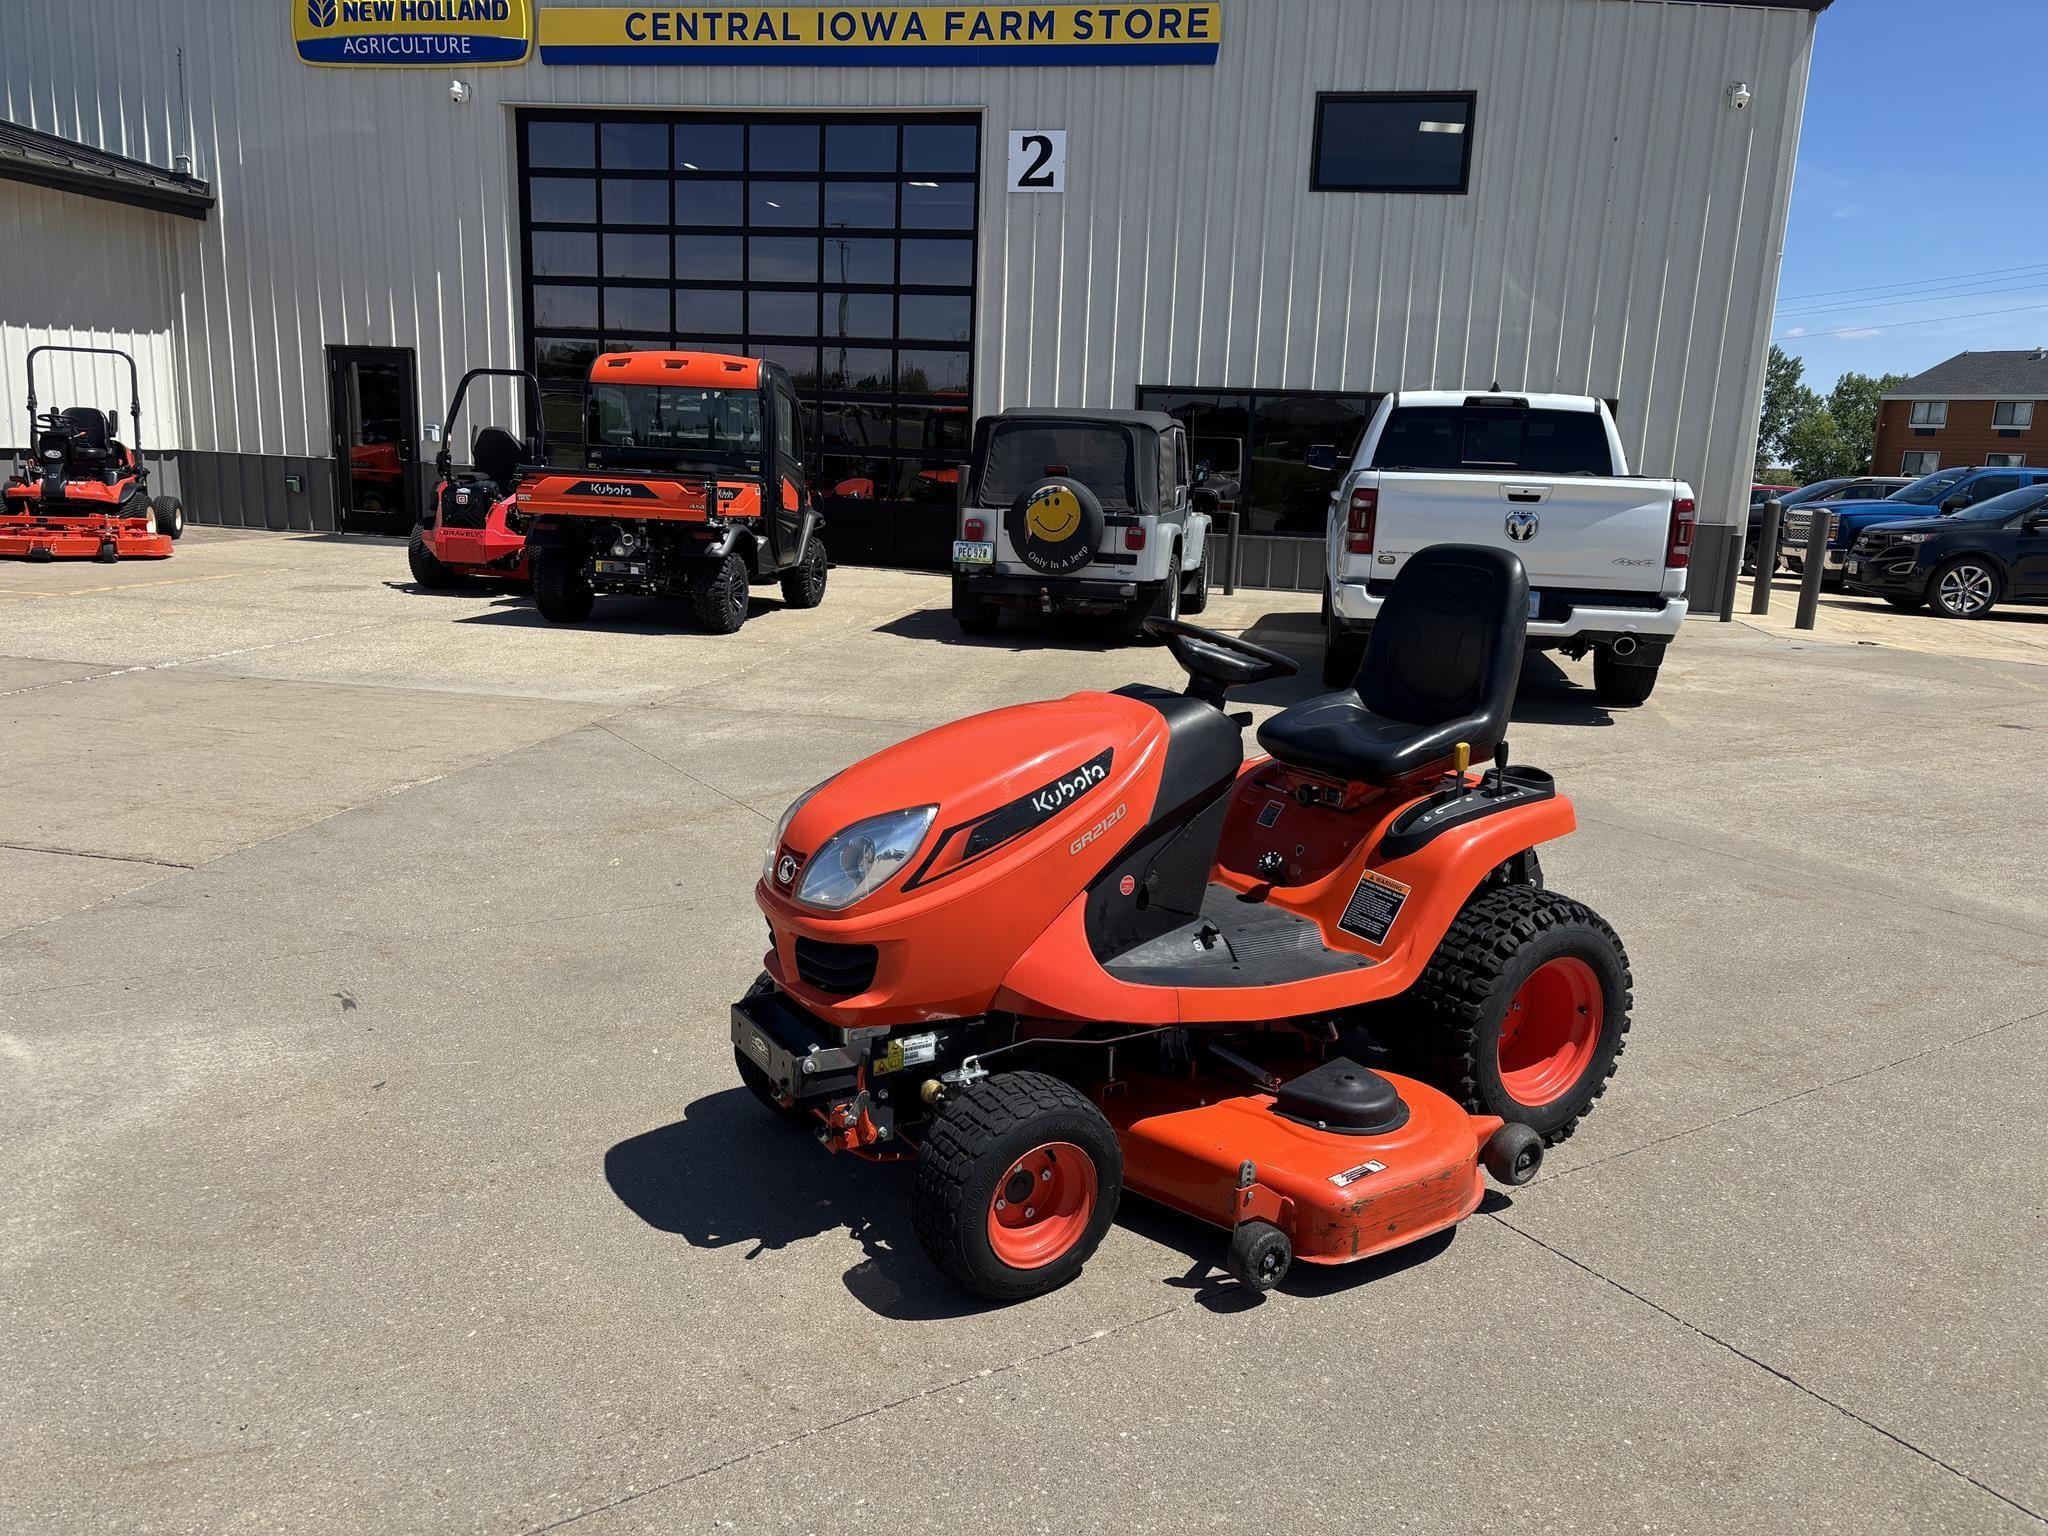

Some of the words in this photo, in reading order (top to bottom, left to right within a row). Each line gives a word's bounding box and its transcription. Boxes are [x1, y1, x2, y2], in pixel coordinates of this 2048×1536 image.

[343, 0, 395, 21] NEW
[401, 0, 509, 21] HOLLAND
[625, 12, 800, 41] CENTRAL
[817, 11, 927, 41] IOWA
[945, 10, 1055, 41] FARM
[1073, 8, 1209, 40] STORE
[343, 37, 471, 54] AGRICULTURE
[1018, 135, 1054, 187] 2
[591, 483, 632, 496] Kubota
[958, 547, 972, 557] PEC
[1028, 551, 1048, 568] Only
[1050, 560, 1060, 569] In
[1062, 560, 1069, 568] A
[1069, 545, 1089, 563] Jeep
[1032, 765, 1106, 812] Kubota
[1070, 803, 1127, 856] GR2120
[1376, 877, 1403, 891] WARNING
